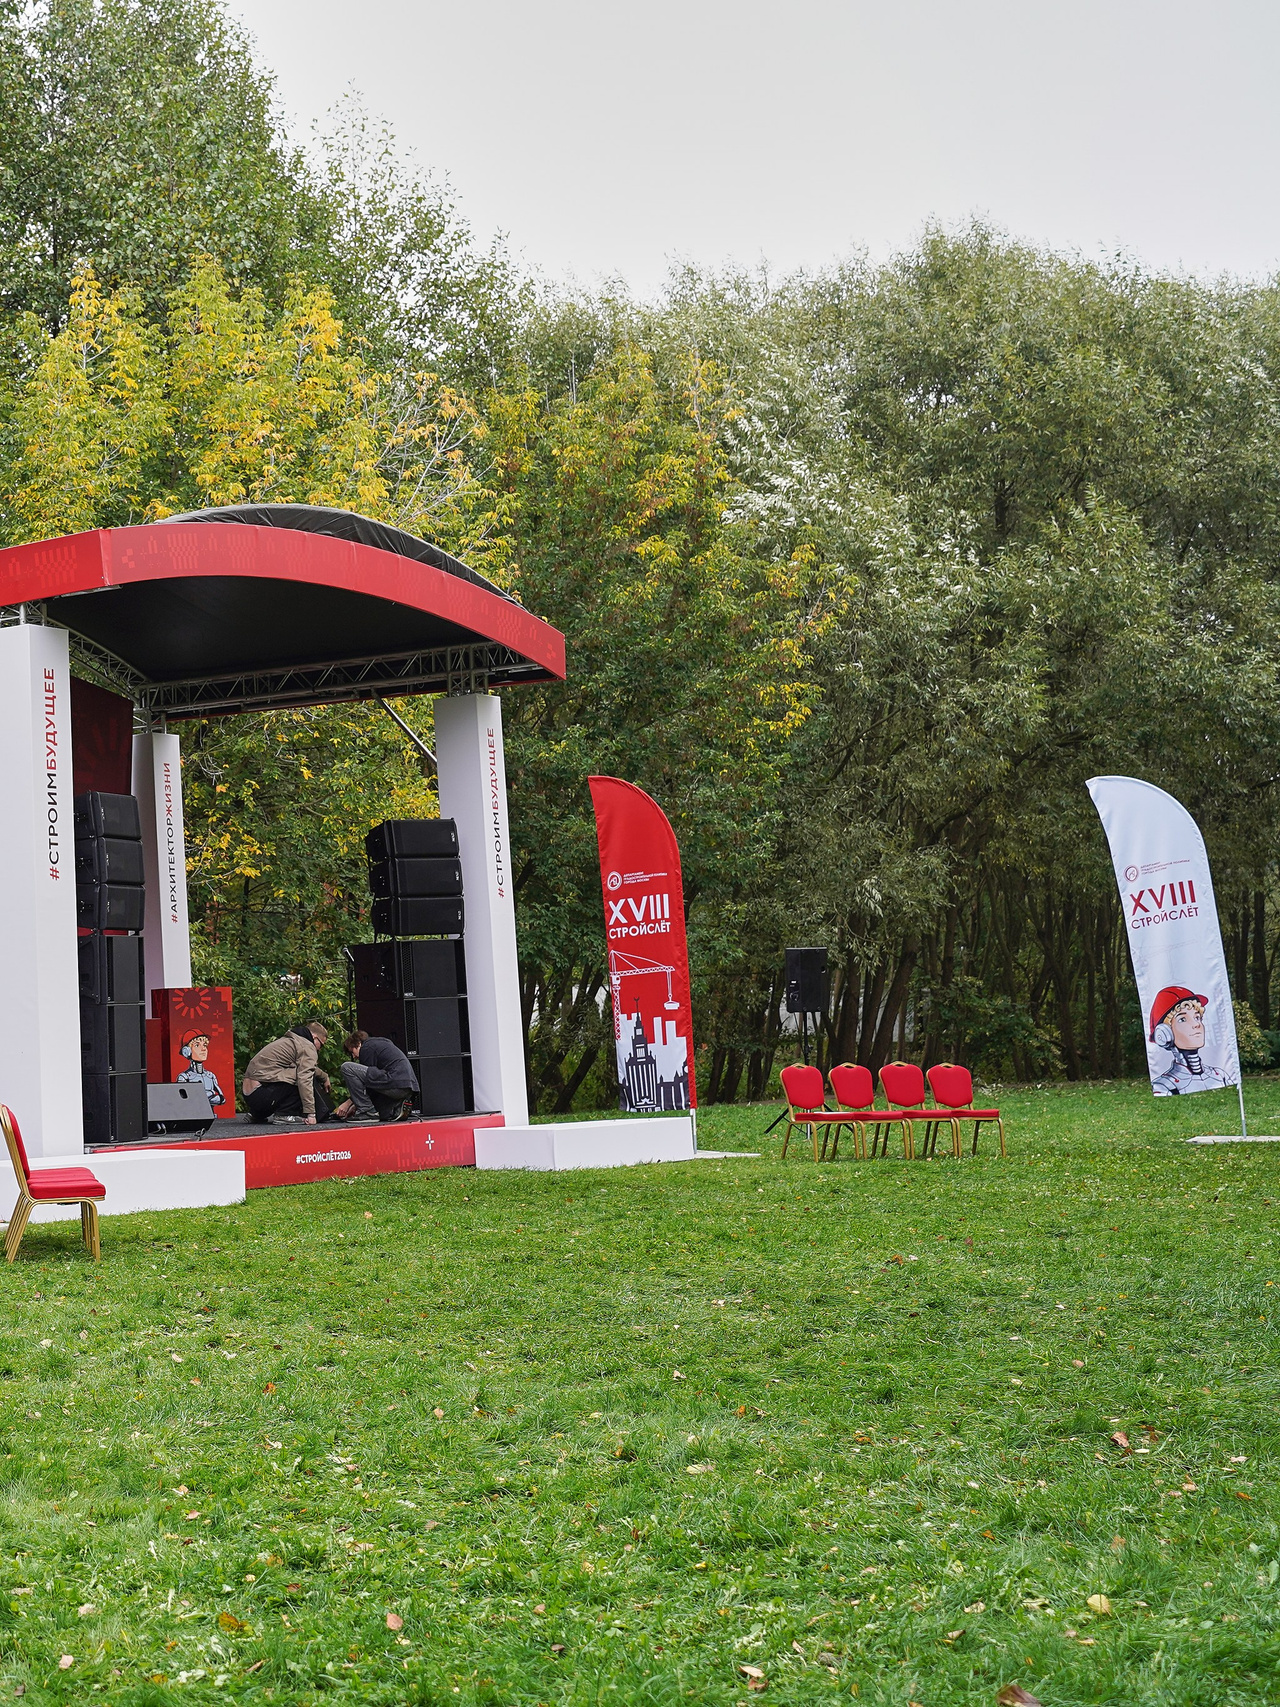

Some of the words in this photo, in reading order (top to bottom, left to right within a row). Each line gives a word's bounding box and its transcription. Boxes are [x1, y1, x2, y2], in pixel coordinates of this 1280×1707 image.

[43, 667, 60, 881] #СТРОИМБУДУЩЕЕ
[486, 727, 505, 899] #СТРОИМБУДУЩЕЕ
[163, 762, 178, 923] #АРХИТЕКТОРЖИЗНИ
[608, 893, 670, 926] XVIII
[1129, 880, 1196, 916] XVIII
[608, 919, 671, 939] СТРОЙСЛЁТ
[1131, 905, 1199, 930] СТРОЙСЛЁТ
[295, 1150, 352, 1164] #СТРОЙСЛЁТ2026
